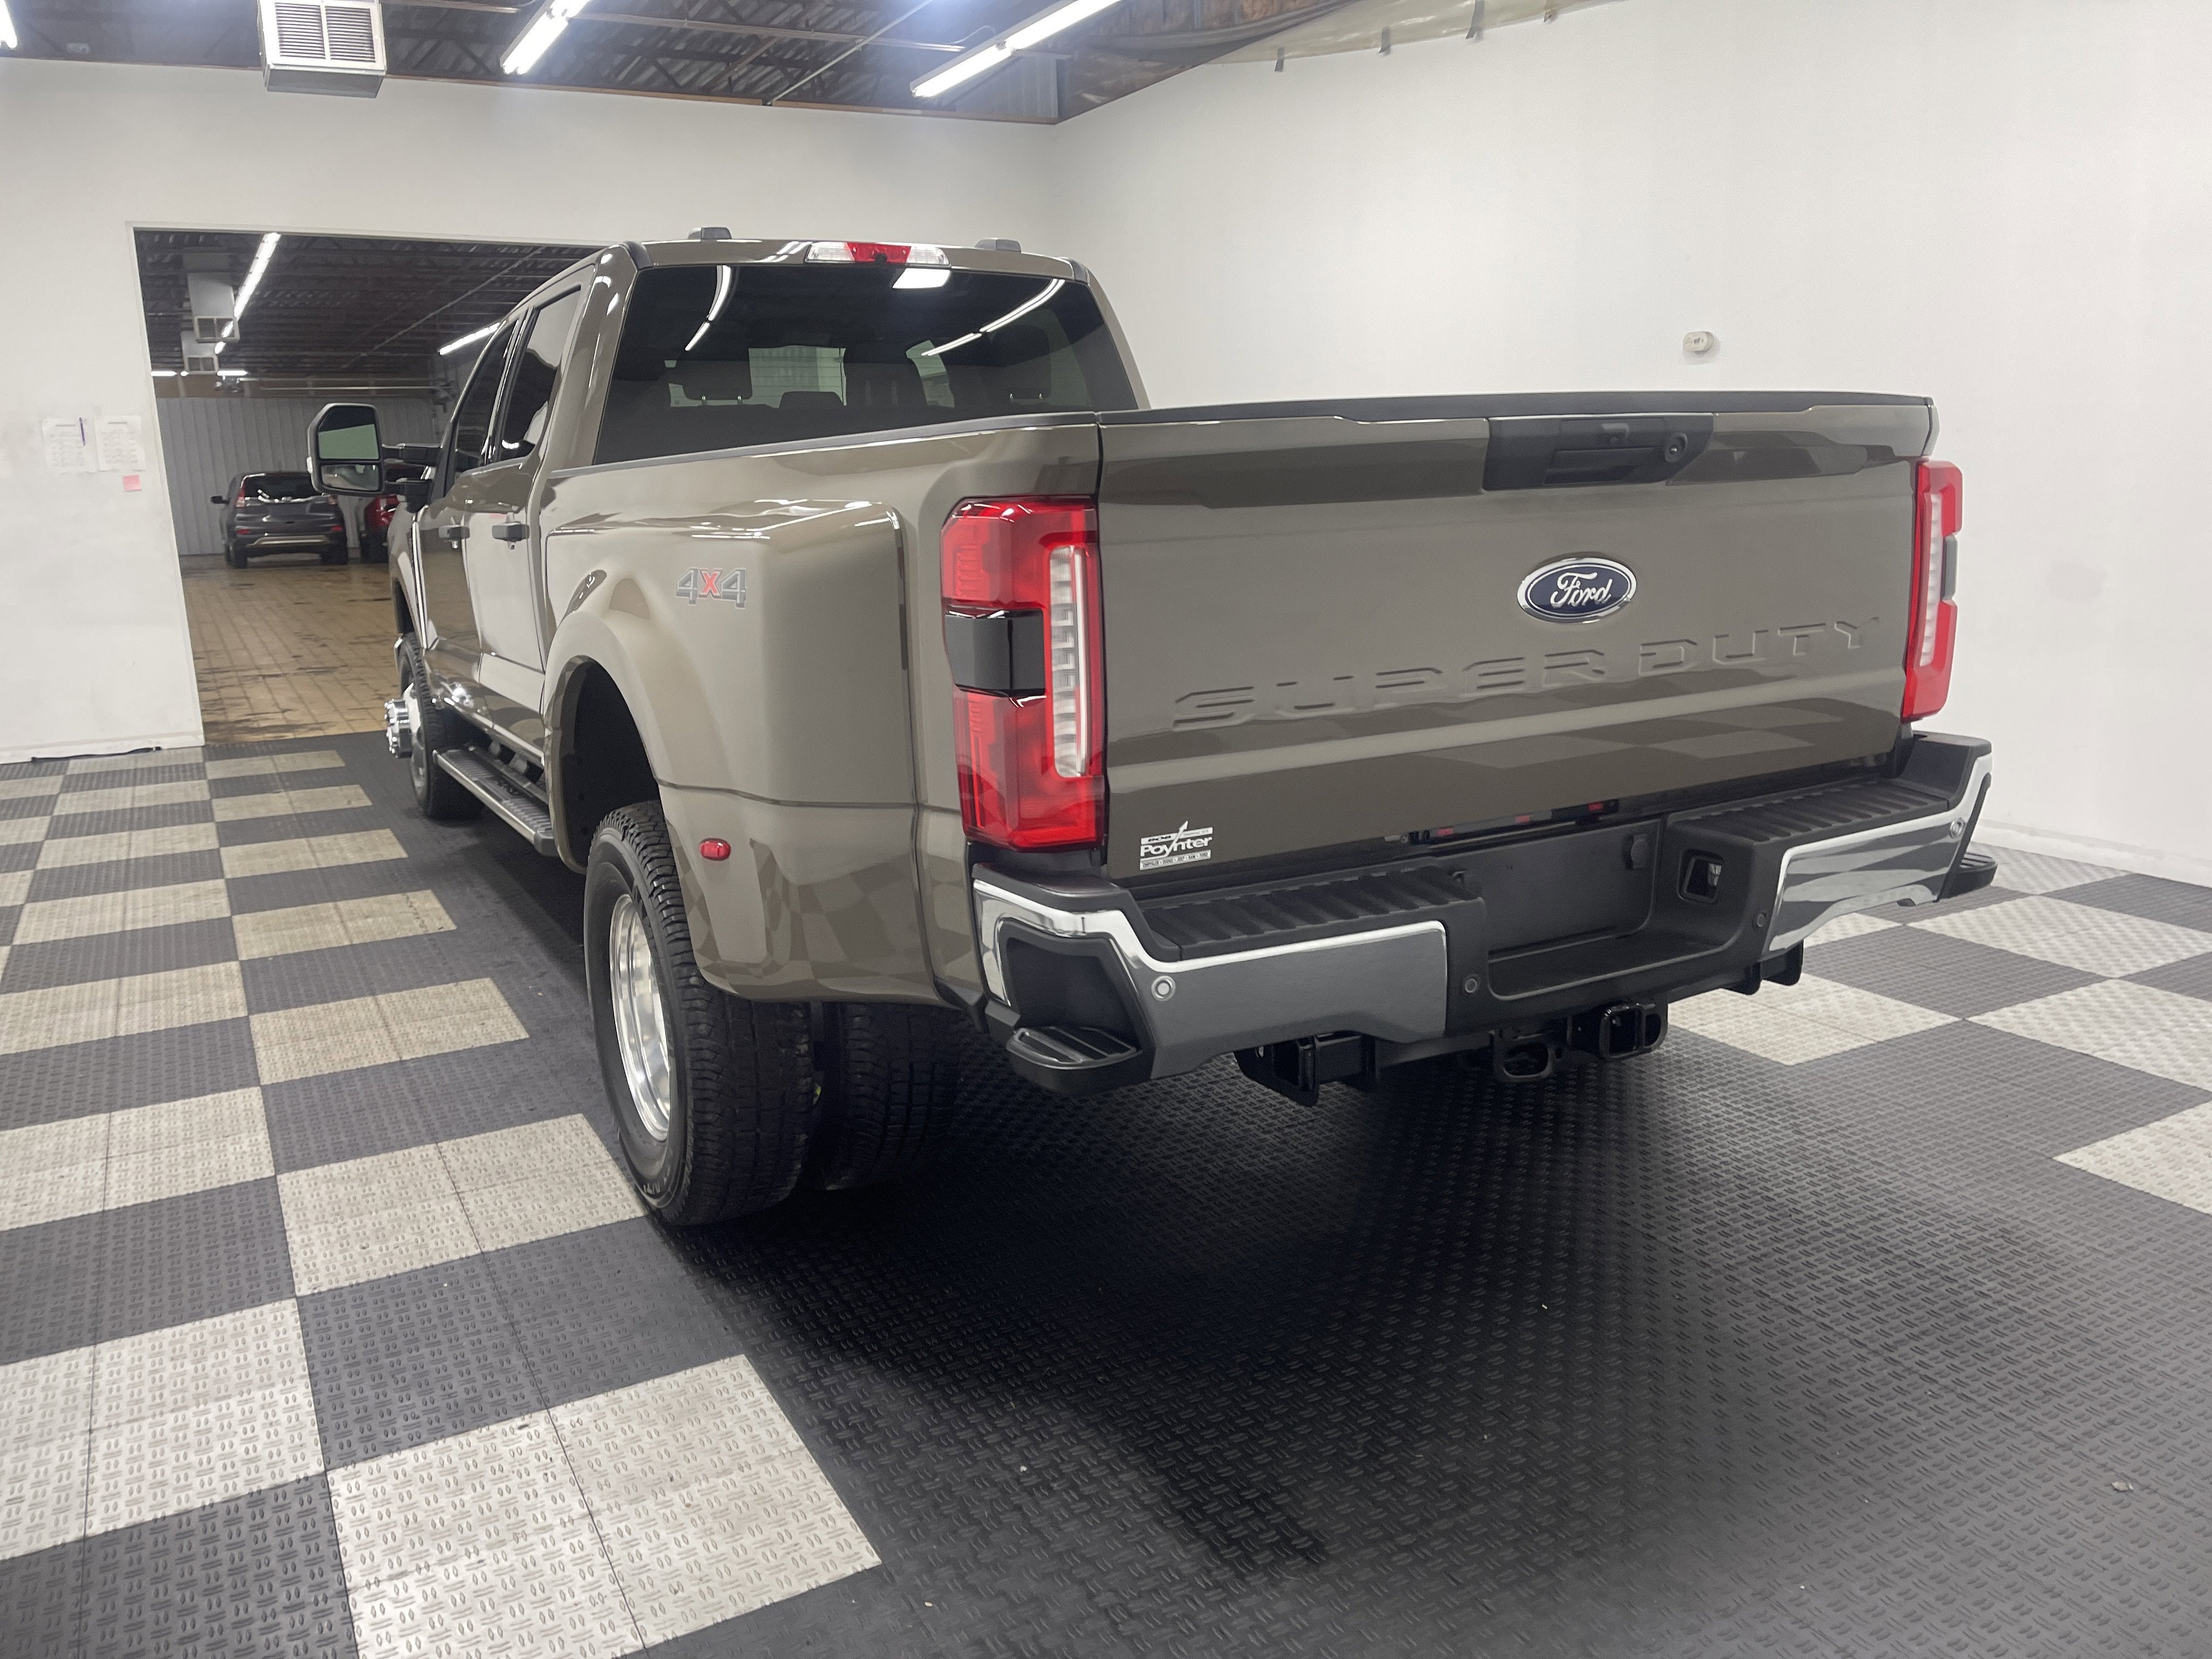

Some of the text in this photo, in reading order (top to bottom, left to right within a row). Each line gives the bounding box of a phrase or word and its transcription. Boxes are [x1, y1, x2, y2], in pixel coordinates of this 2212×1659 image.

[1550, 572, 1613, 608] Ford
[1172, 616, 1880, 732] SUPER DUTY
[1139, 836, 1213, 858] Poynter
